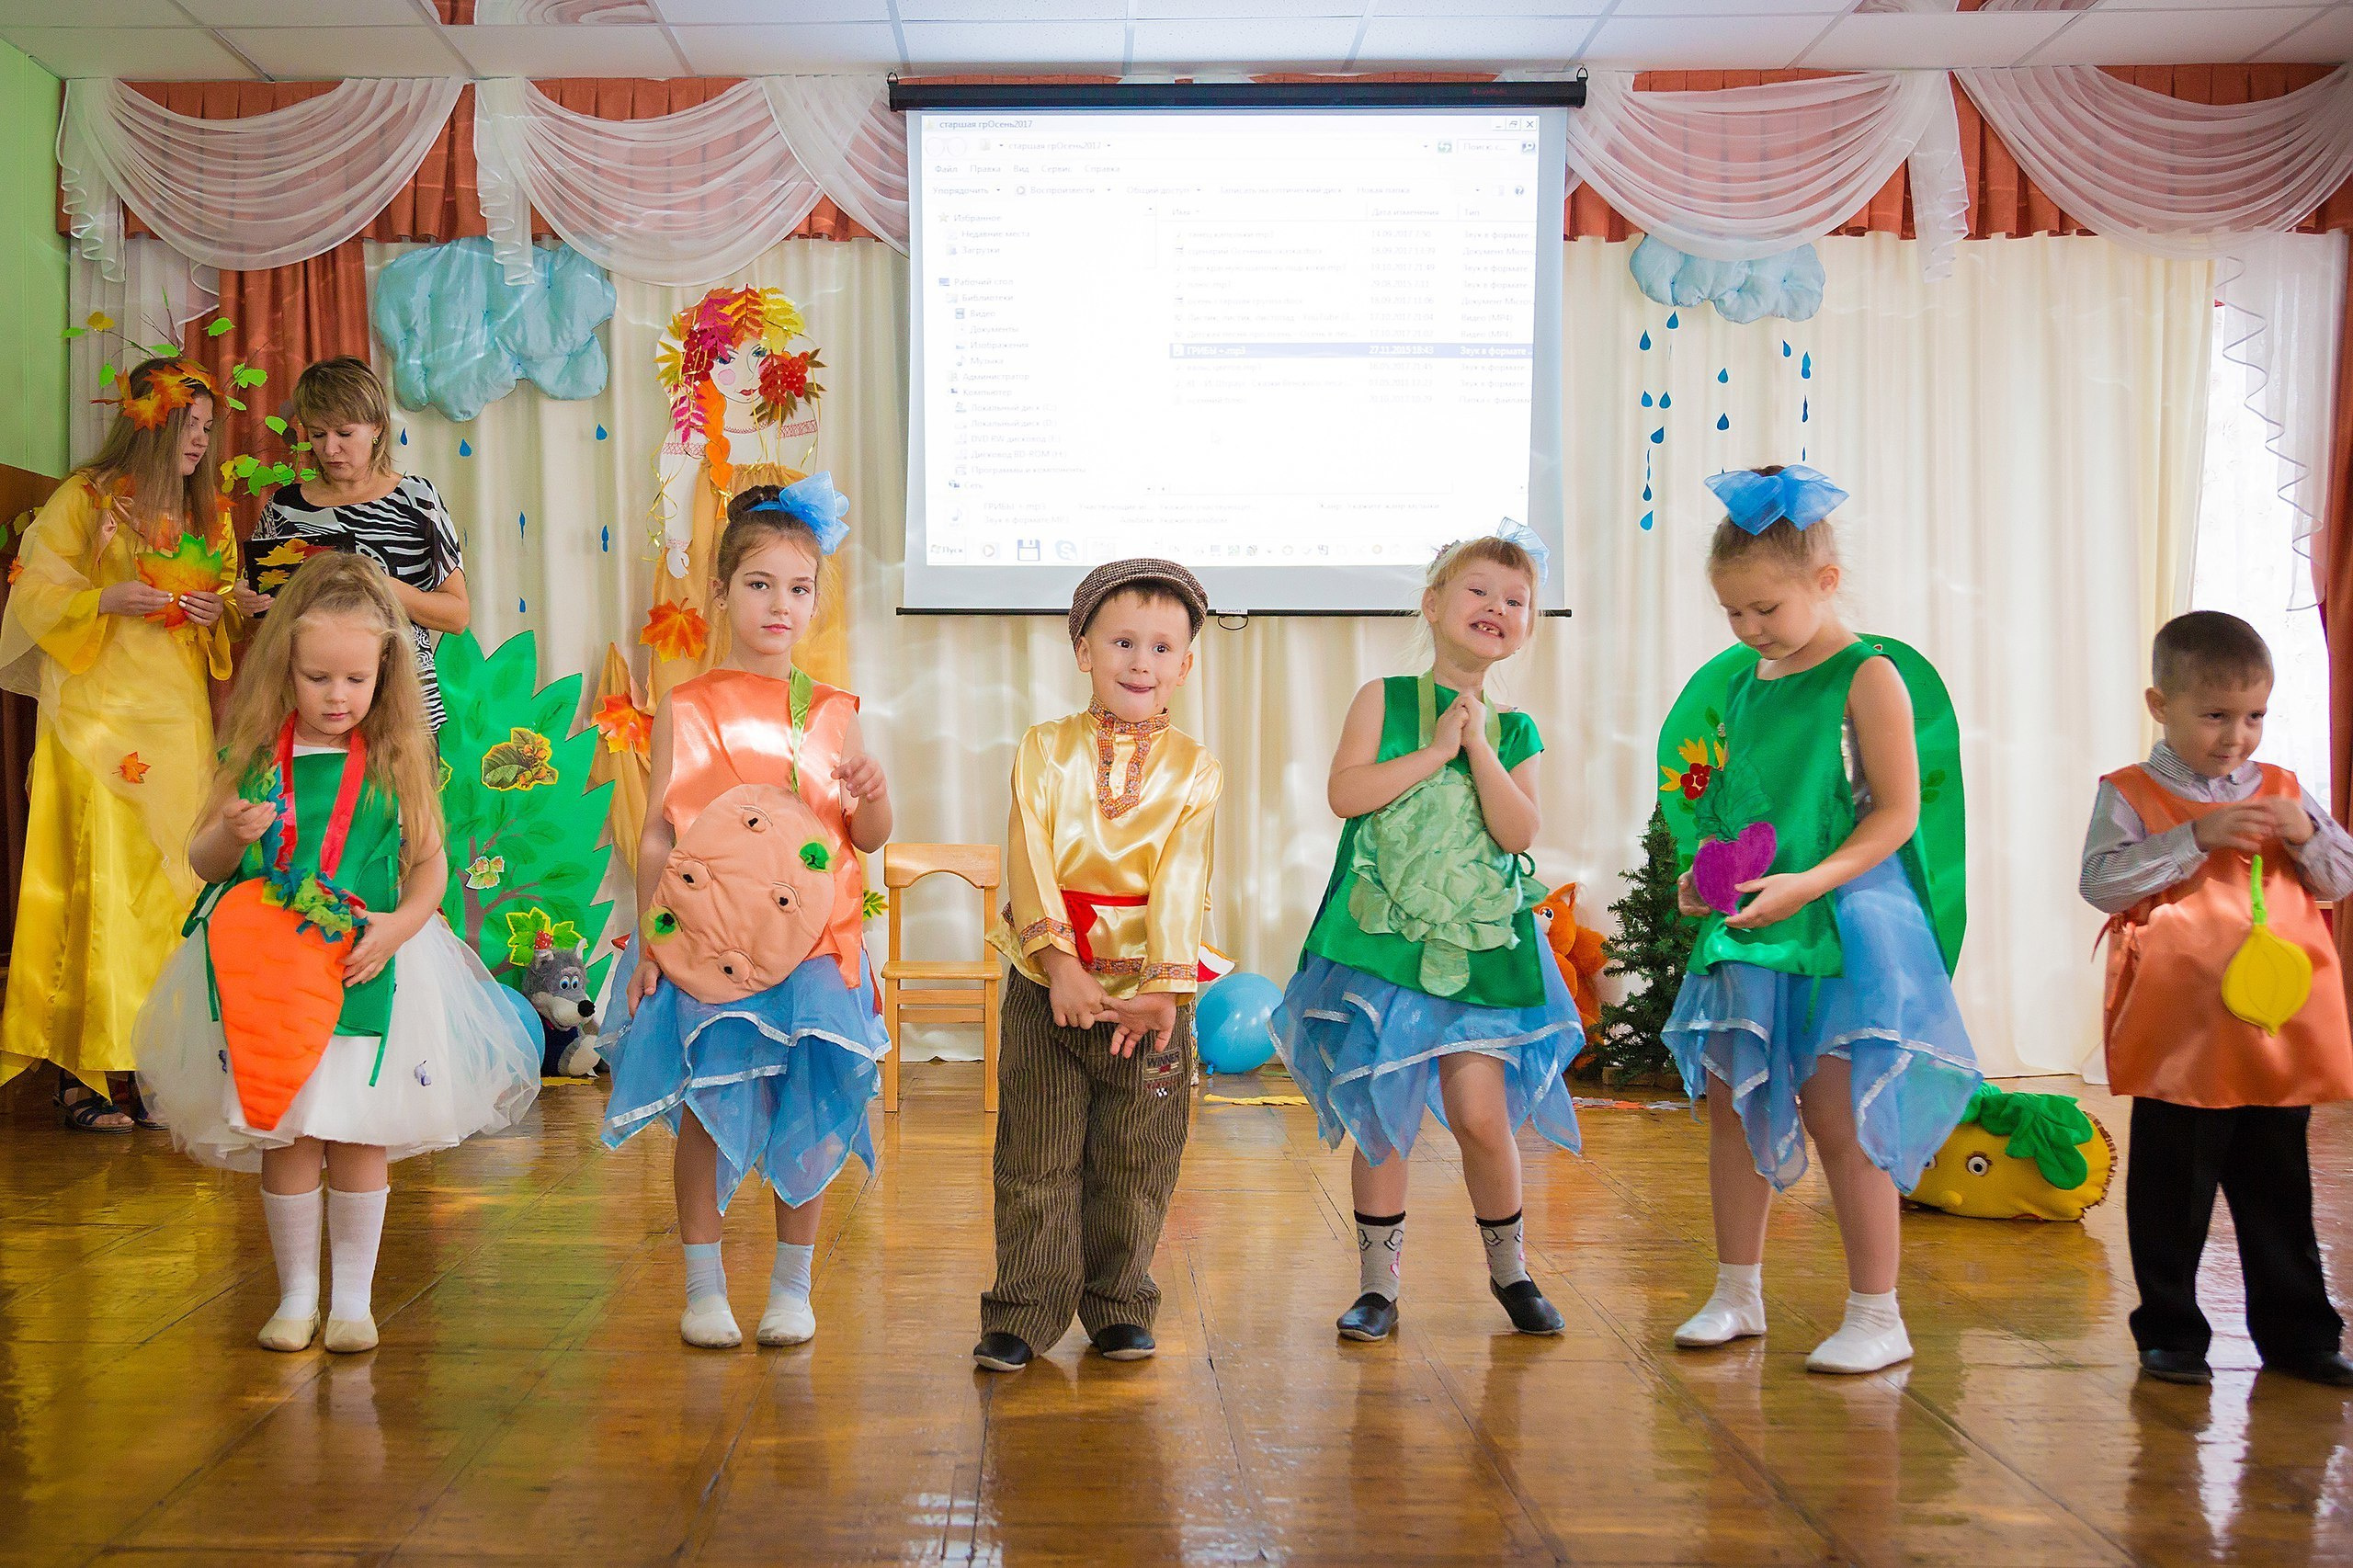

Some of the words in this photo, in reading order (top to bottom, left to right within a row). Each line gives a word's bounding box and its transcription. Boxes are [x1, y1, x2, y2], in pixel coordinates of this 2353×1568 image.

[939, 120, 976, 130] старшая
[978, 119, 1033, 130] грОсень2017
[1008, 142, 1045, 152] старшая
[1047, 142, 1102, 152] грОсень2017
[934, 165, 958, 174] Файл
[970, 165, 1001, 174] Правка
[1013, 165, 1029, 174] Вид
[1041, 165, 1073, 174] Сервис
[1085, 165, 1120, 175] Справка
[932, 187, 989, 196] Упорядочить
[1030, 187, 1095, 196] Воспроизвести
[1127, 186, 1158, 195] Общий
[1371, 209, 1392, 217] Дата
[1464, 209, 1480, 217] Тип
[953, 214, 1001, 222] Избранное
[961, 230, 1002, 238] Недавние
[961, 245, 1000, 255] Загрузки
[954, 277, 992, 286] Рабочий
[961, 293, 1014, 301] Библиотеки
[970, 310, 995, 319] Видео
[1461, 314, 1485, 323] Видео
[1488, 313, 1513, 324] (MP4)
[970, 325, 1019, 335] Документы
[1461, 331, 1485, 339] Видео
[1488, 330, 1512, 340] (MP4)
[970, 341, 1029, 350] Изображения
[1187, 346, 1217, 355] ГРИБЫ
[1369, 346, 1411, 355] 27.11.2015
[1412, 346, 1434, 355] 18:43
[1460, 347, 1480, 356] Звук
[1488, 346, 1527, 357] формате
[970, 358, 1004, 366] Музыка
[963, 373, 1029, 381] Администратор
[963, 388, 1012, 397] Компьютер
[971, 403, 1019, 413] Локальный
[971, 419, 1019, 428] Локальный
[942, 545, 962, 555] Пуск
